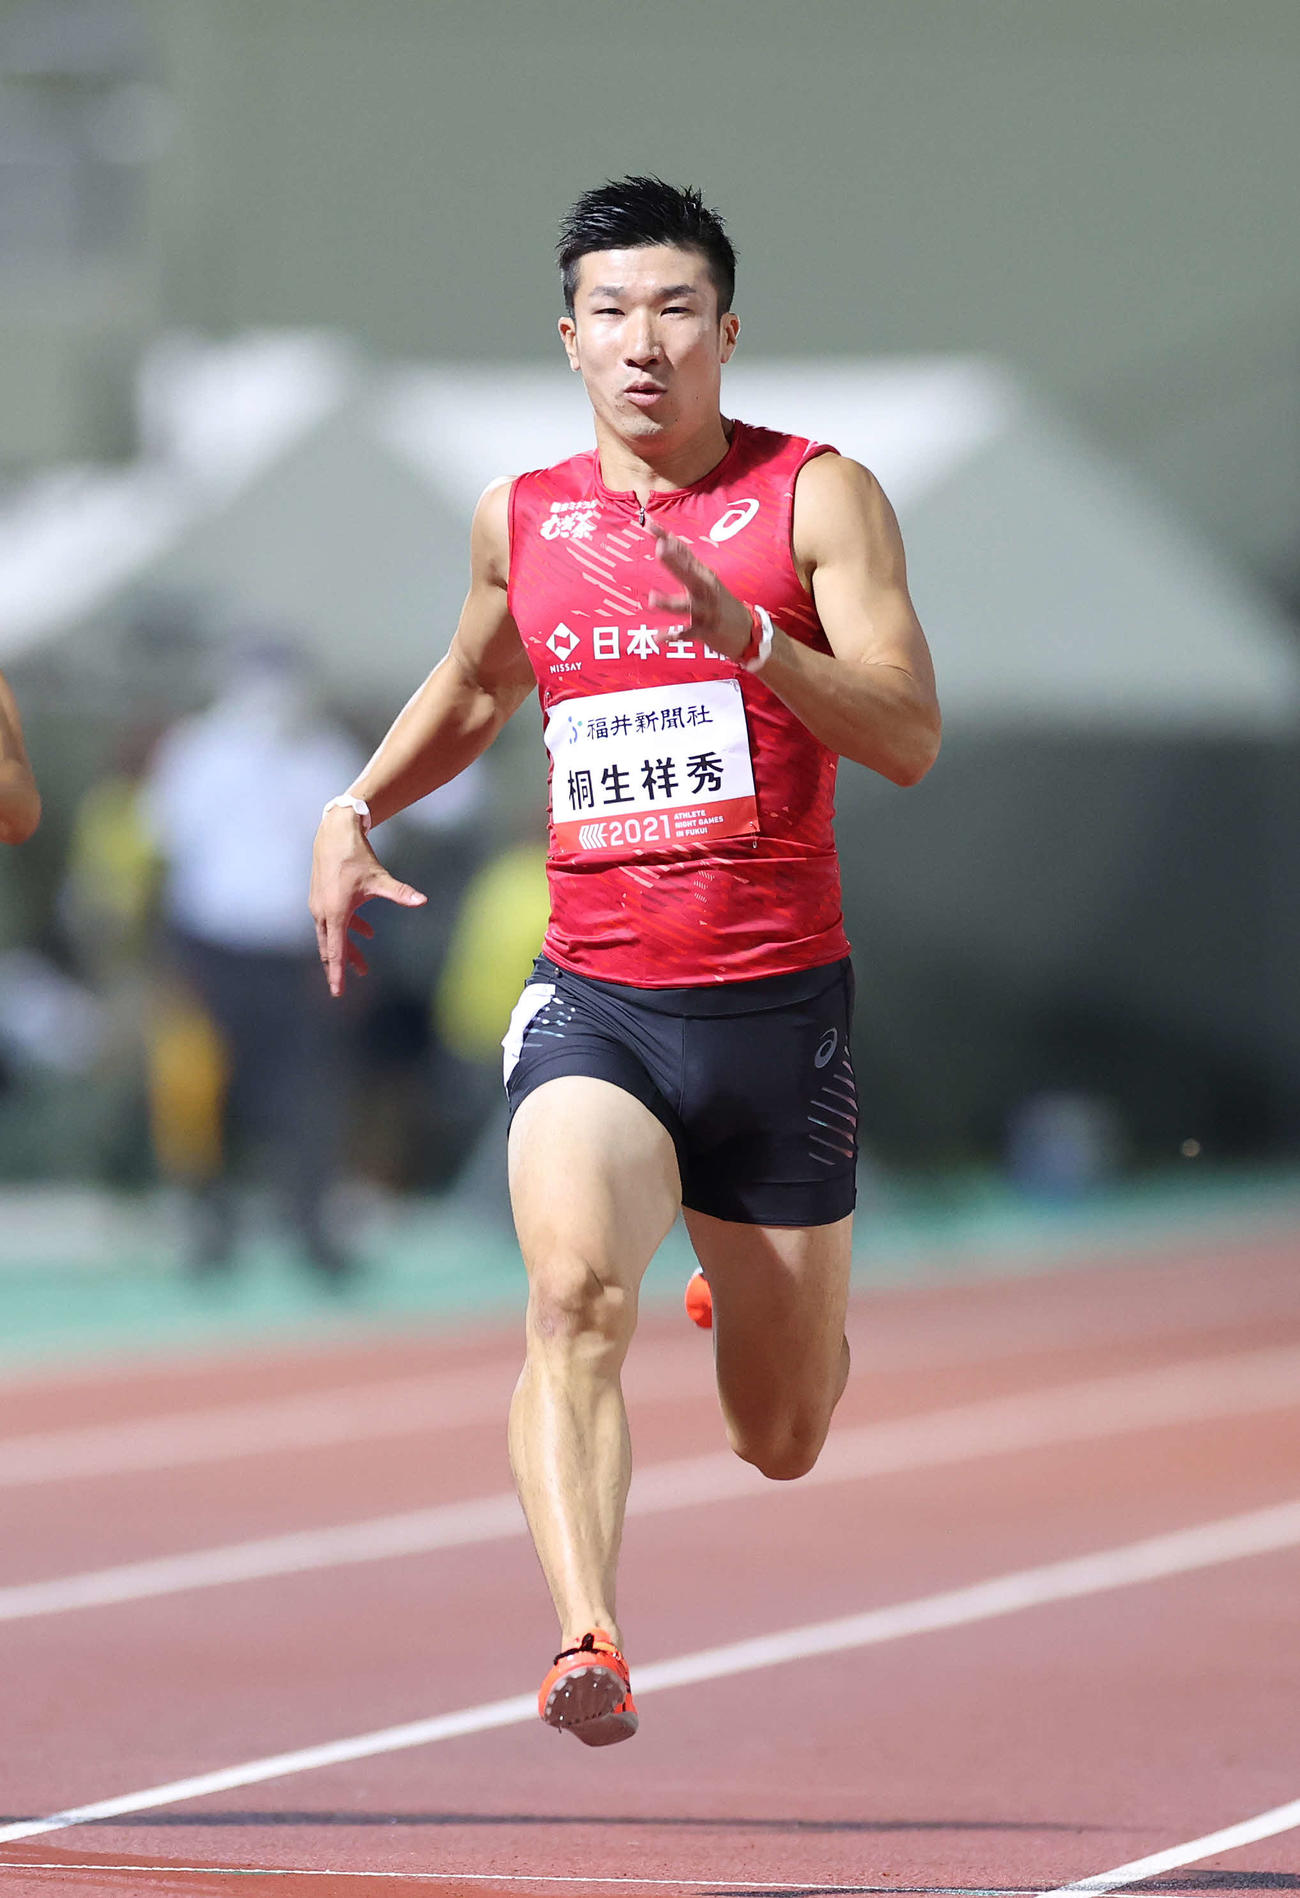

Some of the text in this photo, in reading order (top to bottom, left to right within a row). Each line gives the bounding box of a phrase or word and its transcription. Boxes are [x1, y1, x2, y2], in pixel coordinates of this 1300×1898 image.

[540, 510, 598, 540] むぎ茶
[592, 624, 727, 660] 日本生
[549, 661, 582, 674] NISSAY
[587, 705, 713, 740] 福井新聞社
[568, 752, 724, 811] 桐生祥秀
[674, 810, 705, 820] ATHLETE
[675, 816, 723, 828] NIGHT GAMES
[609, 815, 670, 846] 2021
[685, 828, 707, 836] FUKUI
